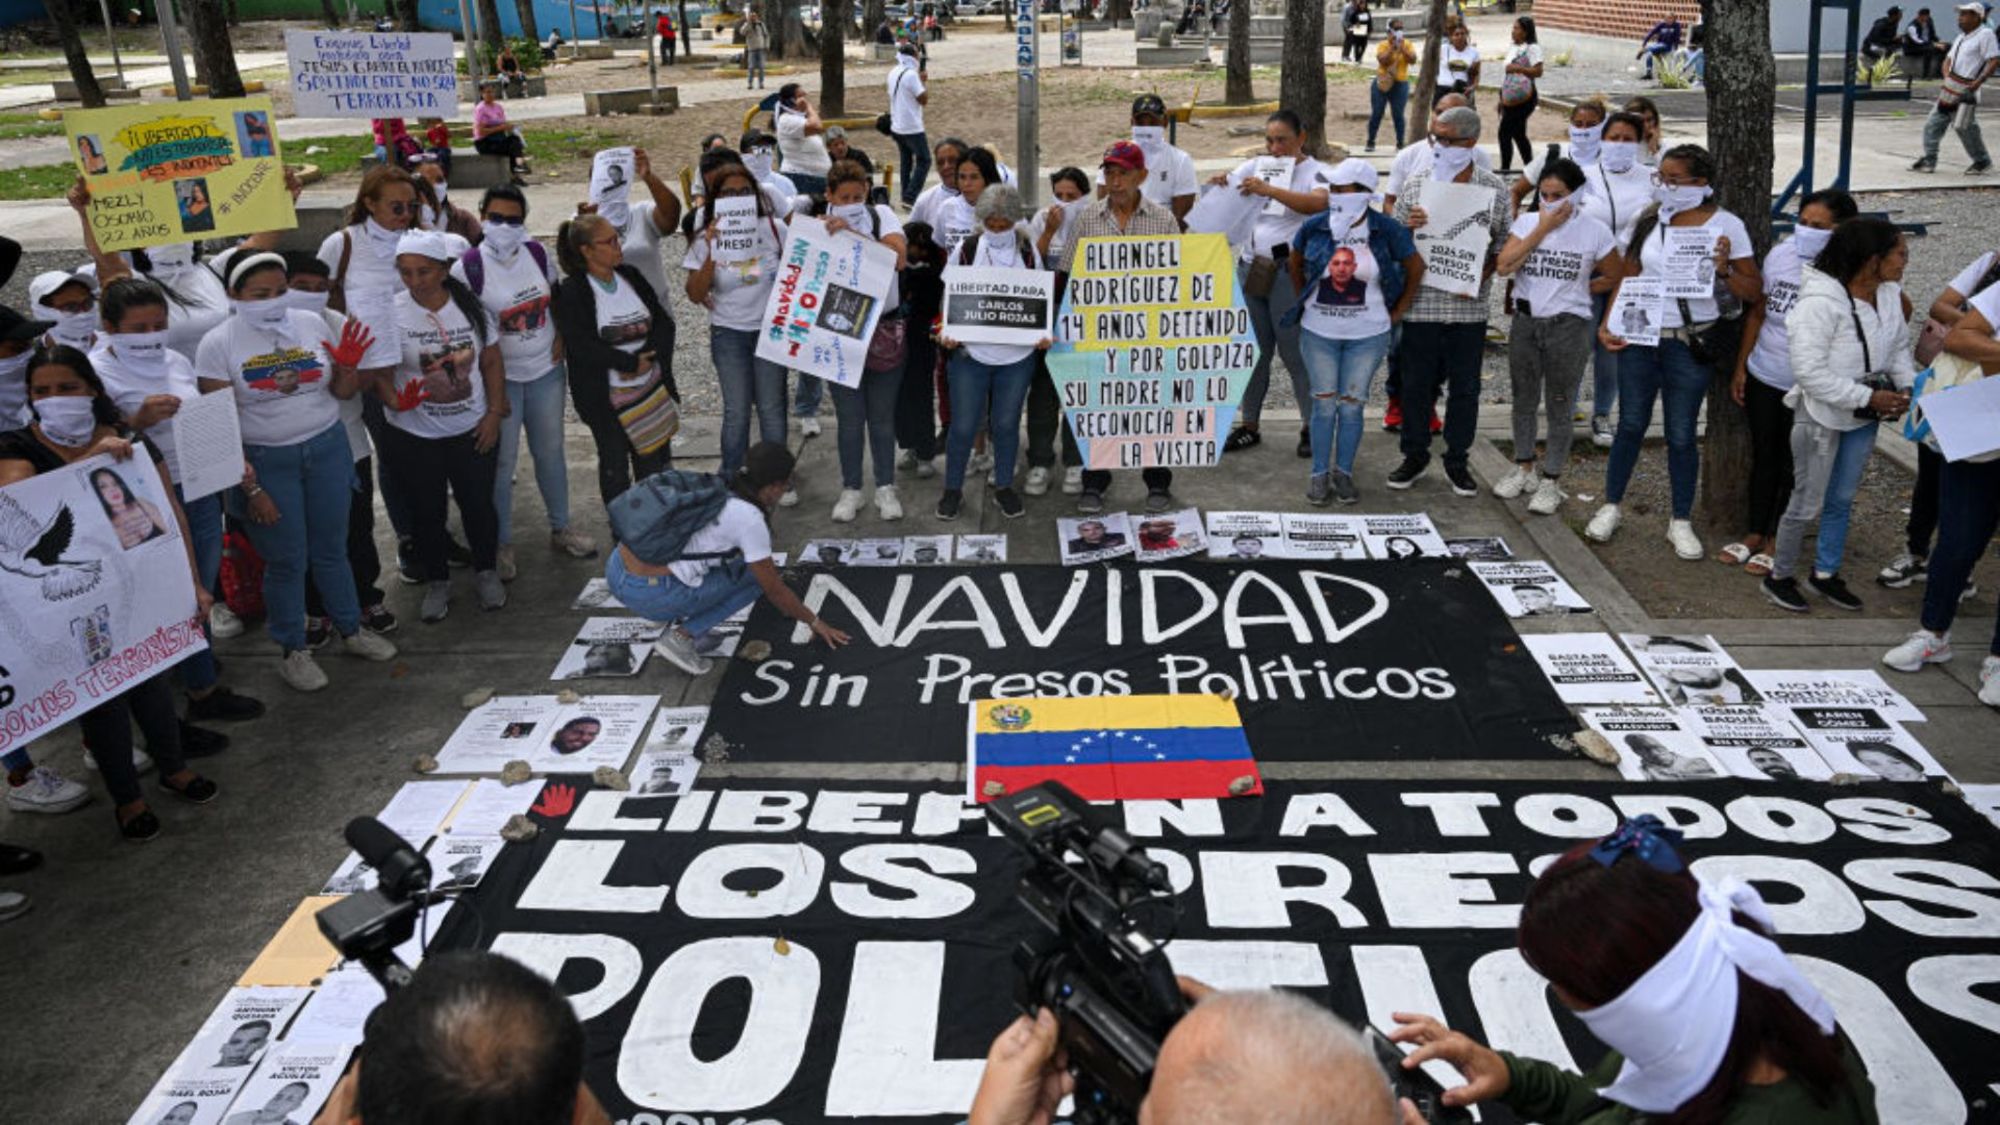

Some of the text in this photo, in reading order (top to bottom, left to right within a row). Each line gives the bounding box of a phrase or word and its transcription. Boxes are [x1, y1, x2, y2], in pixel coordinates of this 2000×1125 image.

[102, 230, 127, 245] 22
[1086, 241, 1179, 271] ALIANGEL
[1541, 256, 1581, 269] PRESOS
[1429, 265, 1476, 282] OLÍTICOS
[950, 282, 1046, 297] LIBERTAD PARA
[1070, 273, 1213, 306] RODRÍGUEZ DE
[964, 309, 1037, 323] JULIO ROJAS
[977, 300, 1024, 311] CARLOS
[1061, 309, 1248, 342] 14 AÑOS DETENIDO
[1106, 343, 1254, 373] Y POR GOLPIZA
[1065, 376, 1227, 407] SU MADRE NO LO
[1075, 407, 1205, 437] RECONOCÍA EN
[1120, 440, 1216, 467] LA VISITA
[789, 568, 1390, 650] NAVIDAD
[740, 653, 1457, 707] Sin Presos Políticos
[1703, 715, 1769, 724] BADUEL
[1814, 712, 1865, 720] KAREN
[1279, 791, 1378, 837] A
[1400, 791, 1953, 846] TODOS
[515, 840, 977, 920] LOS
